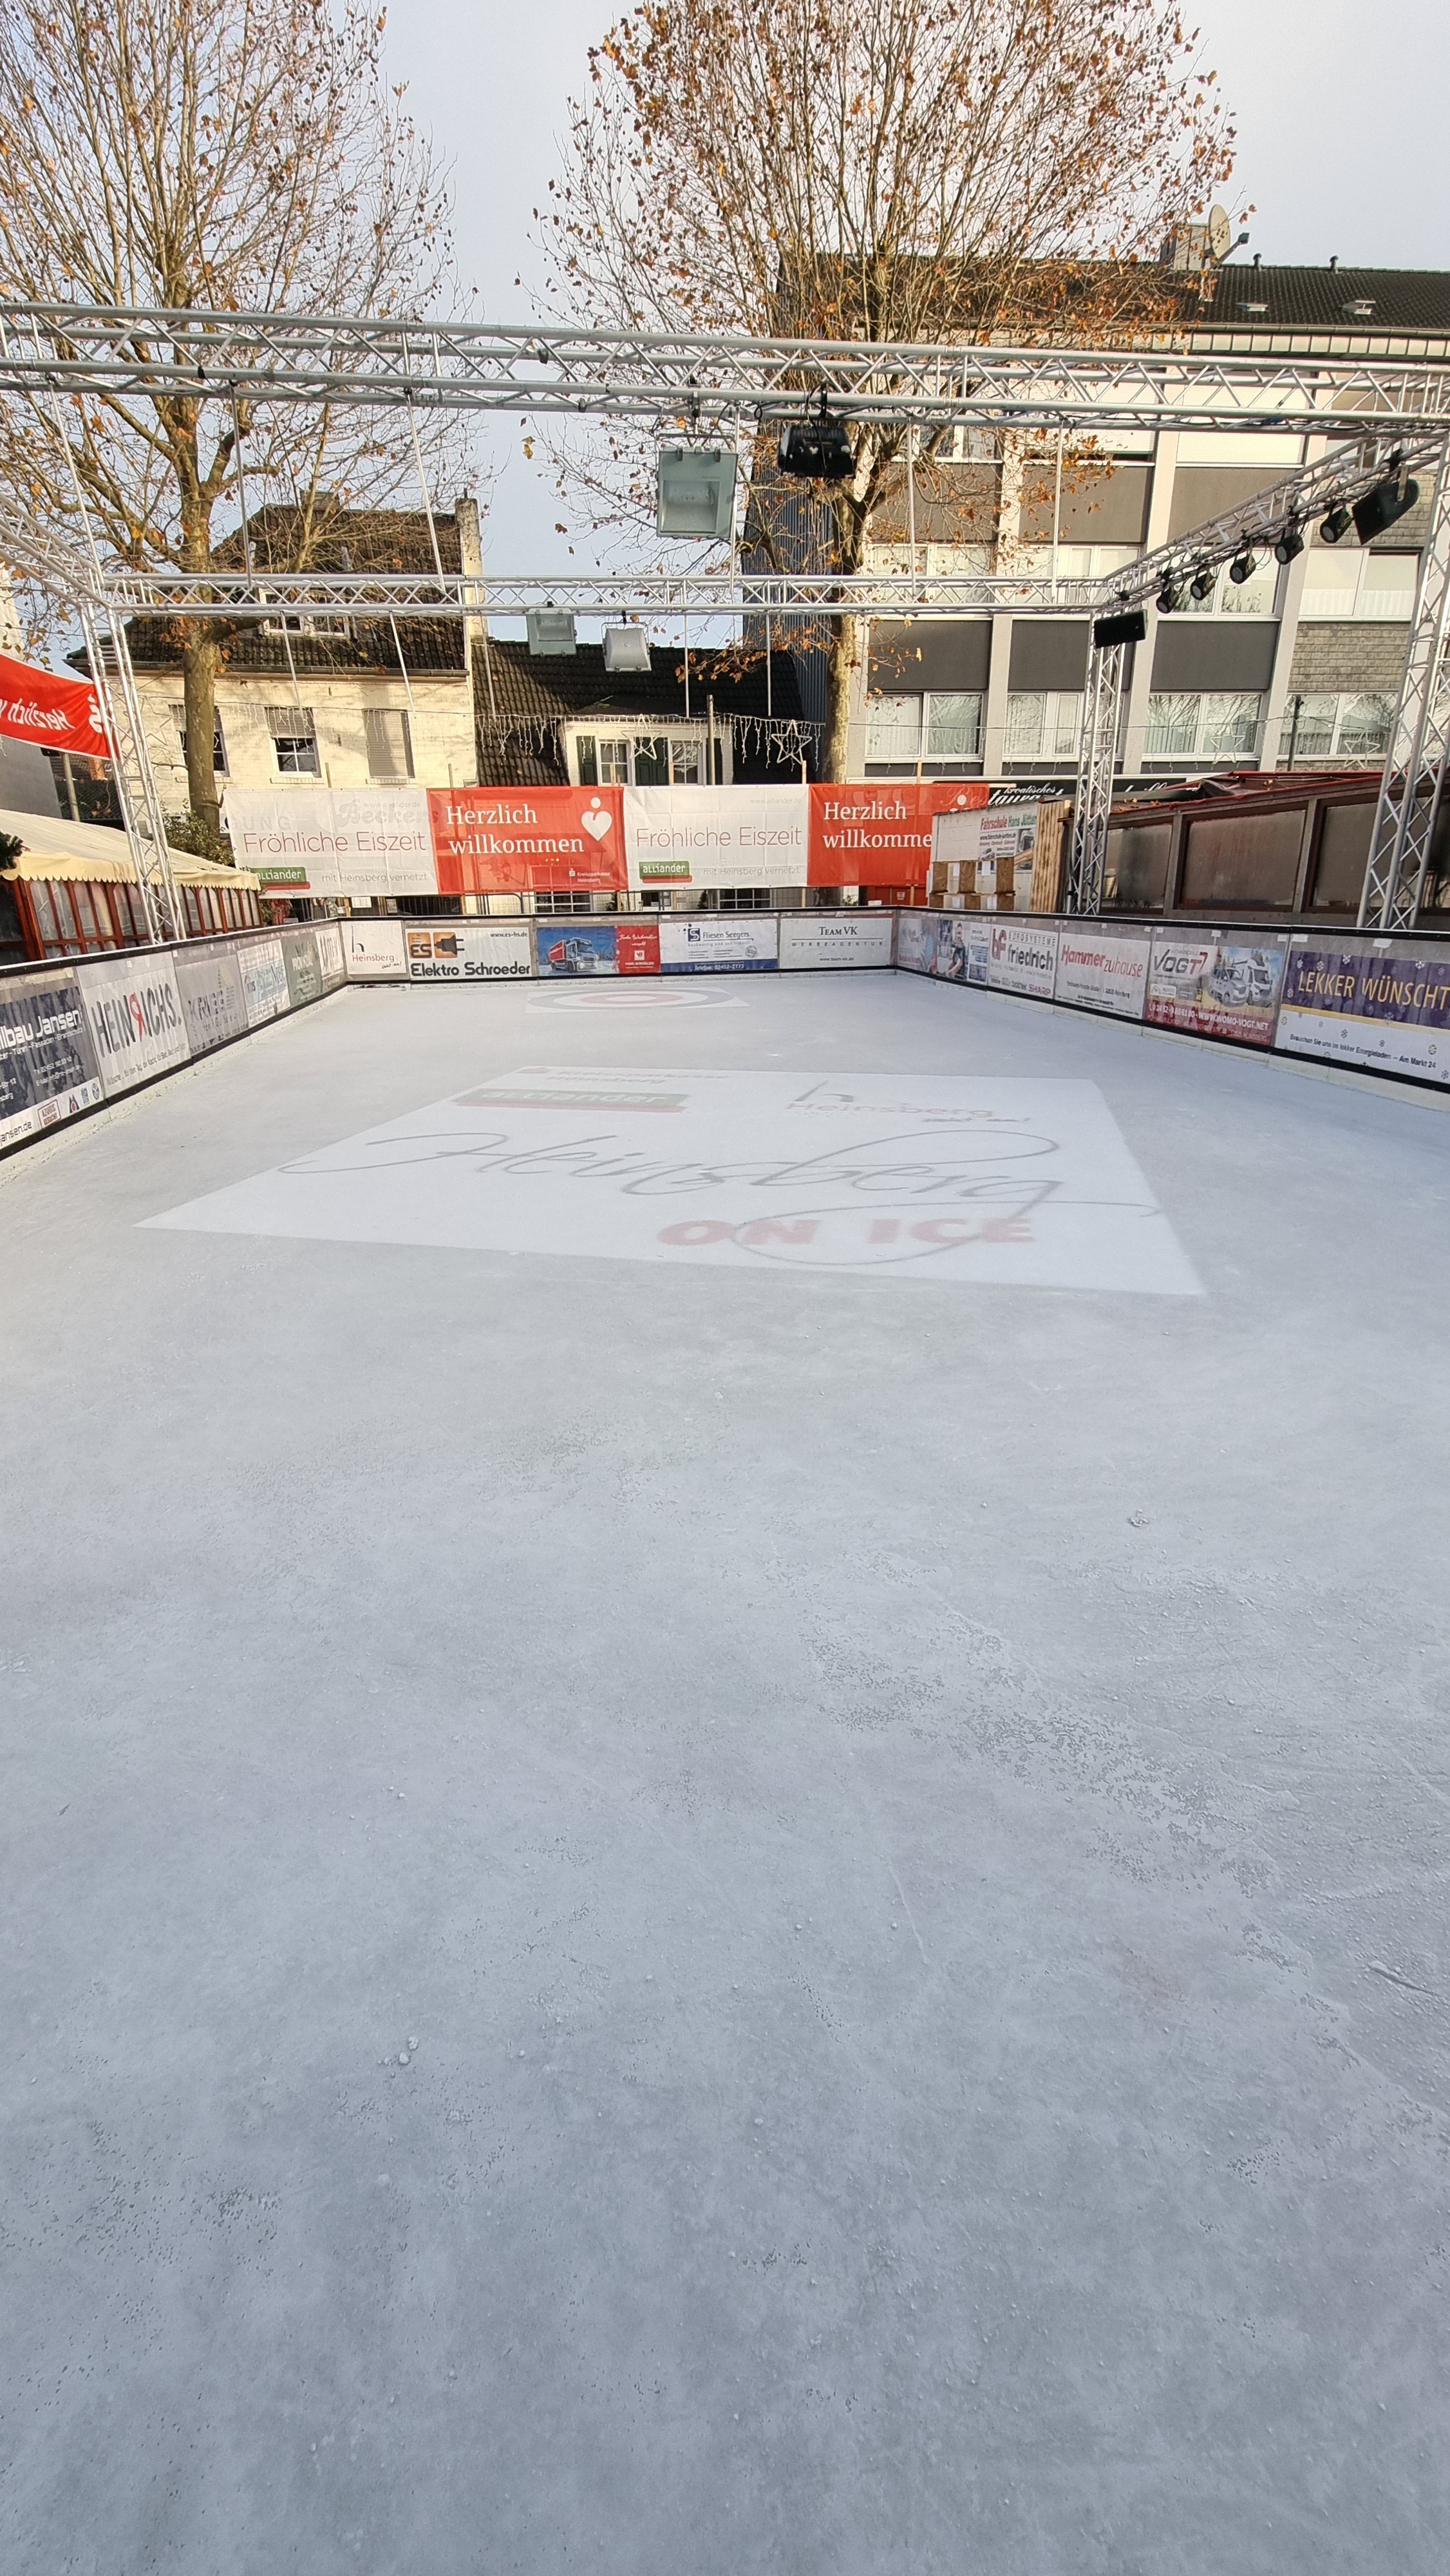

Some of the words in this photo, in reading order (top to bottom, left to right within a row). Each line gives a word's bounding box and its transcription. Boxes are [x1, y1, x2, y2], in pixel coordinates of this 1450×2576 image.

[1003, 782, 1056, 794] kroatisches
[446, 803, 538, 825] Herzlich
[824, 800, 907, 820] Herzlich
[980, 815, 1008, 831] Fahrschule
[1008, 815, 1021, 828] Hans
[243, 831, 348, 853] Fröhliche
[356, 831, 427, 851] Eiszeit
[448, 833, 585, 855] willkommen
[636, 827, 731, 848] Fröhliche
[739, 826, 802, 846] Eiszeit
[823, 829, 932, 849] willkomme
[256, 869, 302, 881] alliander
[322, 873, 337, 883] mit
[339, 873, 387, 884] Heinsberg
[390, 873, 428, 882] vernetzt
[642, 864, 686, 874] alliander
[703, 867, 717, 876] mit
[720, 867, 762, 877] Heinsberg
[725, 931, 749, 940] Seegers
[843, 926, 858, 935] VK
[352, 953, 395, 963] Heinsberg
[1008, 944, 1053, 971] friedrich
[1060, 945, 1106, 967] Hammer
[1104, 956, 1144, 978] zuhause
[1153, 949, 1204, 974] VOGT
[411, 962, 460, 976] Elektro
[464, 961, 531, 976] Schroeder
[1298, 971, 1355, 998] LEKKER
[1361, 974, 1450, 1010] WÜNSCHT
[0, 1022, 34, 1051] llbau
[35, 1009, 82, 1038] Jansen
[1290, 1033, 1313, 1045] Besuchen
[1313, 1037, 1321, 1046] Sie
[1321, 1040, 1332, 1048] uns
[1339, 1043, 1355, 1052] lekker
[1398, 1055, 1410, 1064] Am
[1410, 1057, 1427, 1068] Markt
[1427, 1060, 1437, 1069] 24
[786, 1102, 995, 1118] Heinsberg
[0, 1121, 33, 1142] ansen.de
[278, 1129, 1159, 1265] Heinsberg
[657, 1218, 820, 1246] ON
[866, 1217, 1037, 1245] ICE
